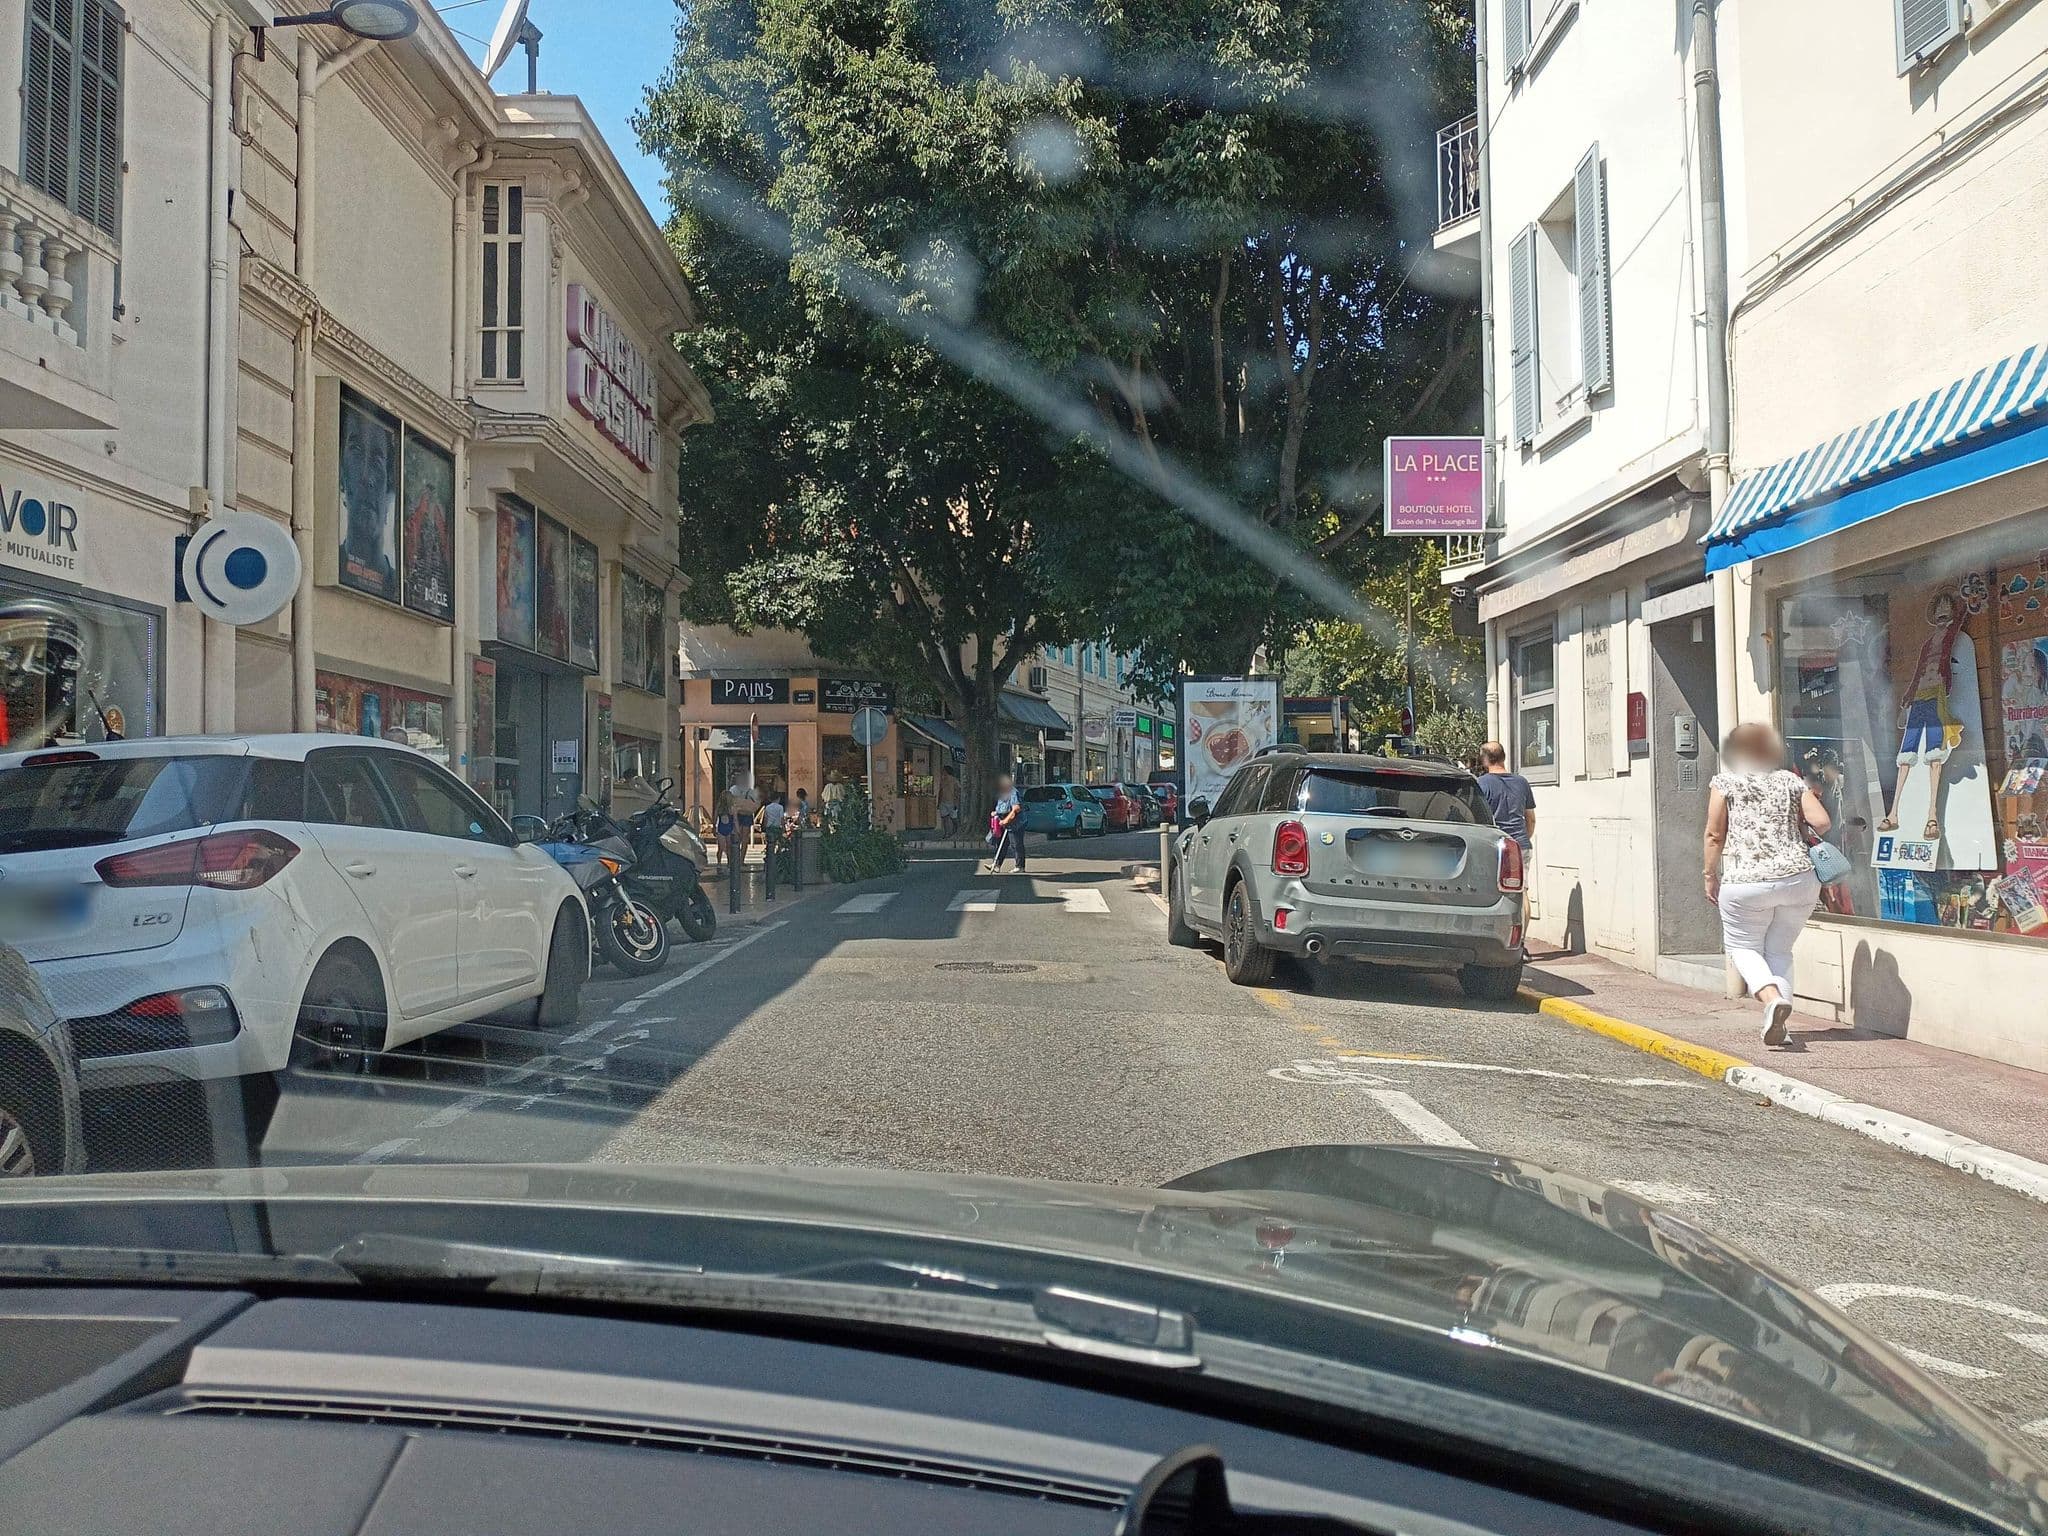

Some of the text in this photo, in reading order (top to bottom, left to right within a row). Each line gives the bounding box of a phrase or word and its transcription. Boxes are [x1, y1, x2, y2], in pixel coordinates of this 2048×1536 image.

[1395, 455, 1479, 471] LA PLACE
[1399, 505, 1473, 515] BOUTIQUE HOTEL
[1441, 518, 1465, 527] Lounge
[7, 541, 75, 570] MUTUALISTE
[1586, 639, 1608, 657] PLACE
[725, 679, 774, 698] PAINS
[1636, 700, 1644, 717] H
[1330, 878, 1477, 892] COUNTRYMAN
